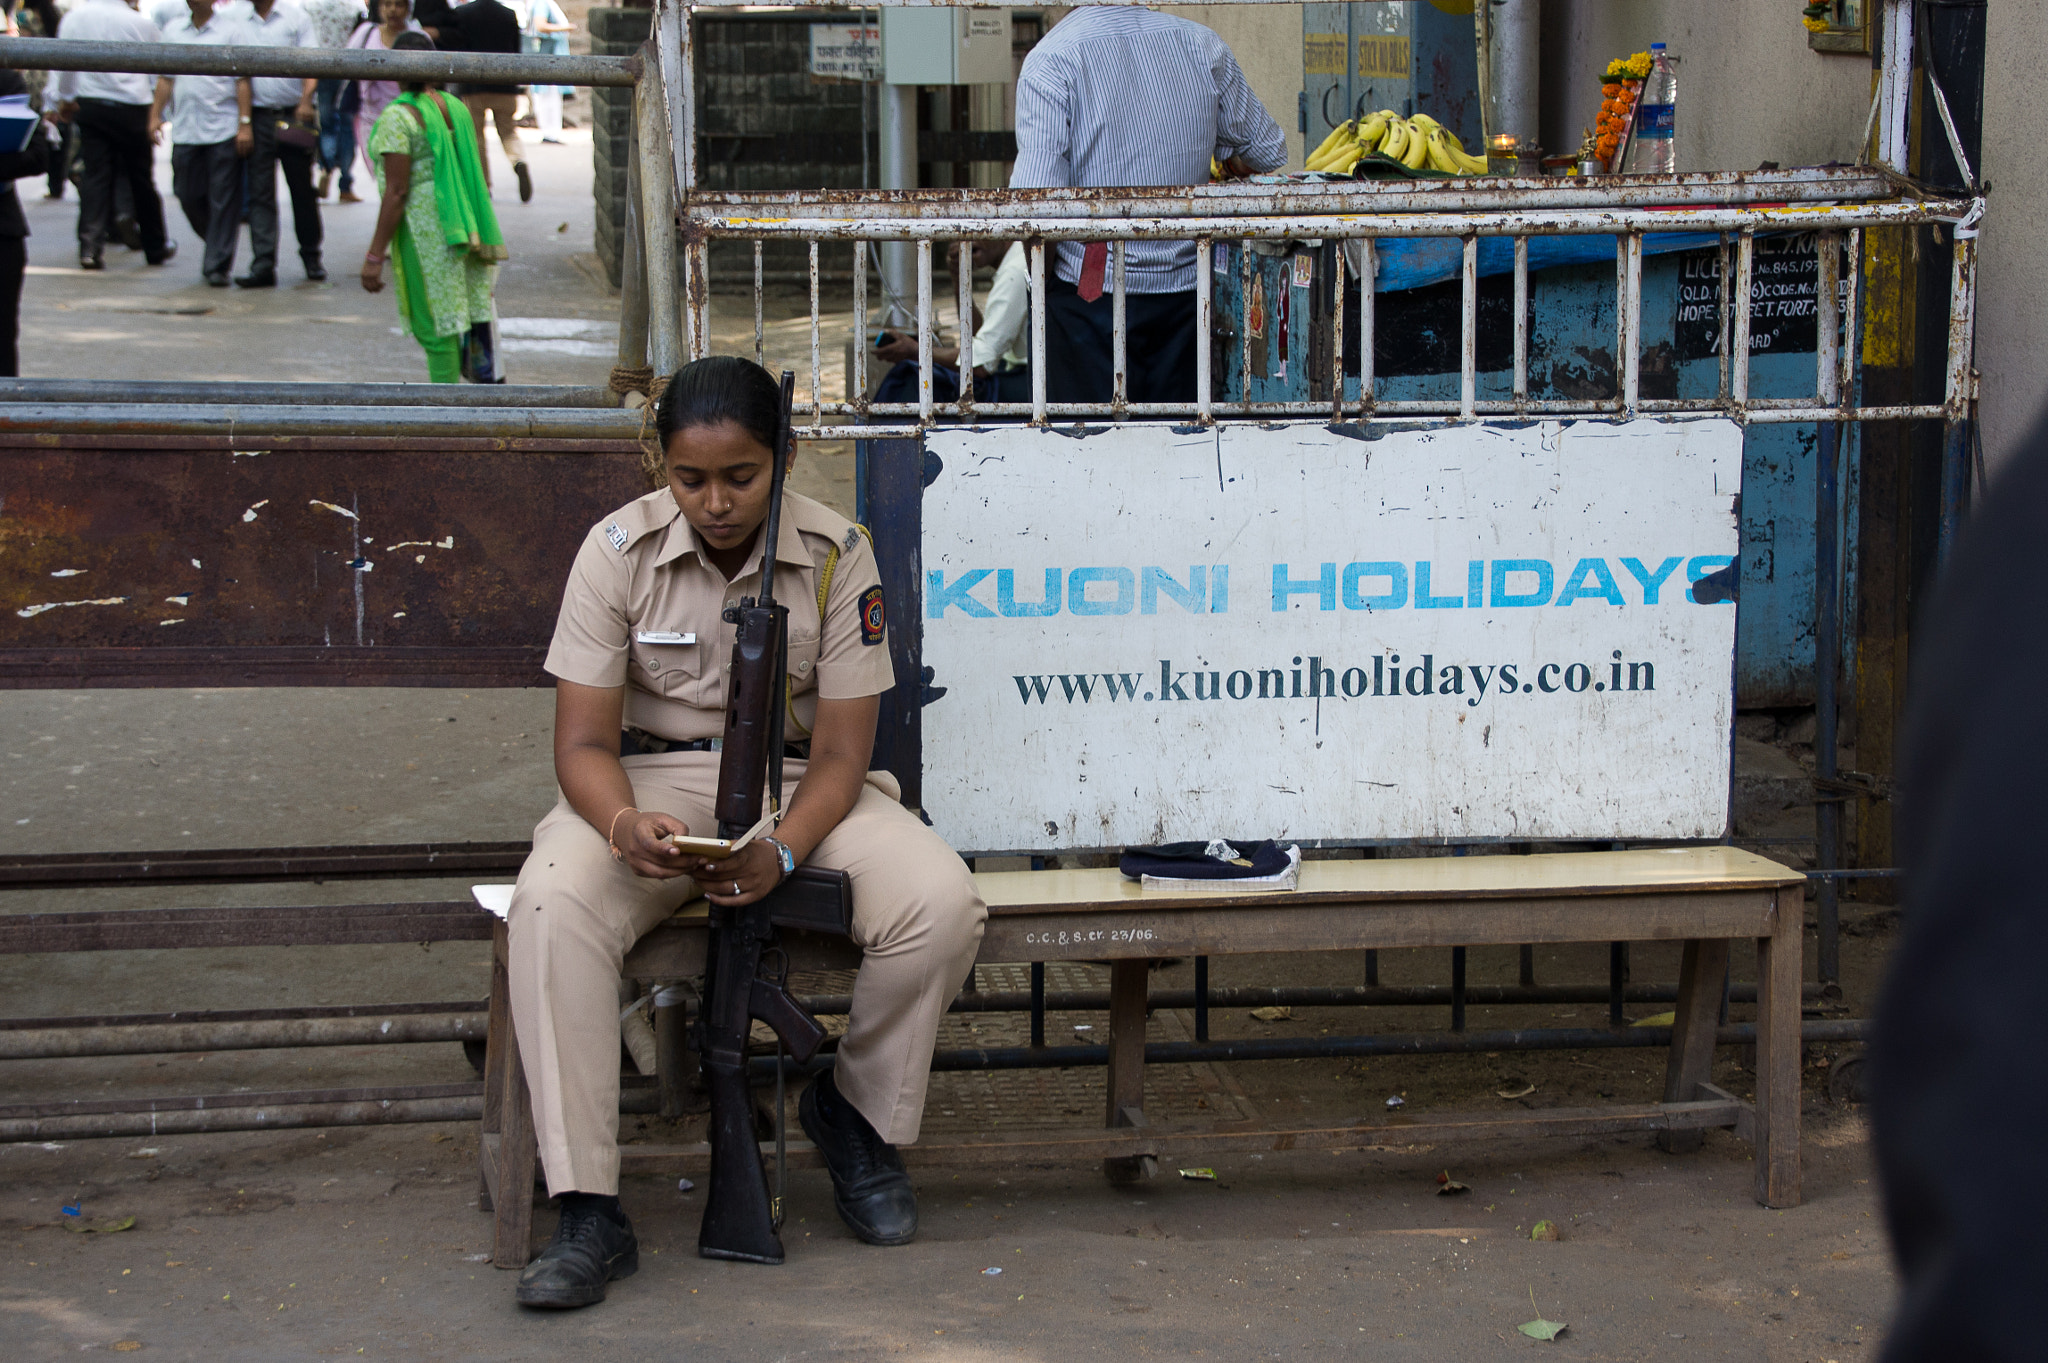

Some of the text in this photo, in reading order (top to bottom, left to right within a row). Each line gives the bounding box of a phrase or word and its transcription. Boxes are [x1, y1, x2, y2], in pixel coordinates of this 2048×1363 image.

[1678, 304, 1715, 321] HOPE
[926, 554, 1735, 619] KUONI HOLIDAYS
[1012, 649, 1656, 706] www.kuoniholidays.co.in
